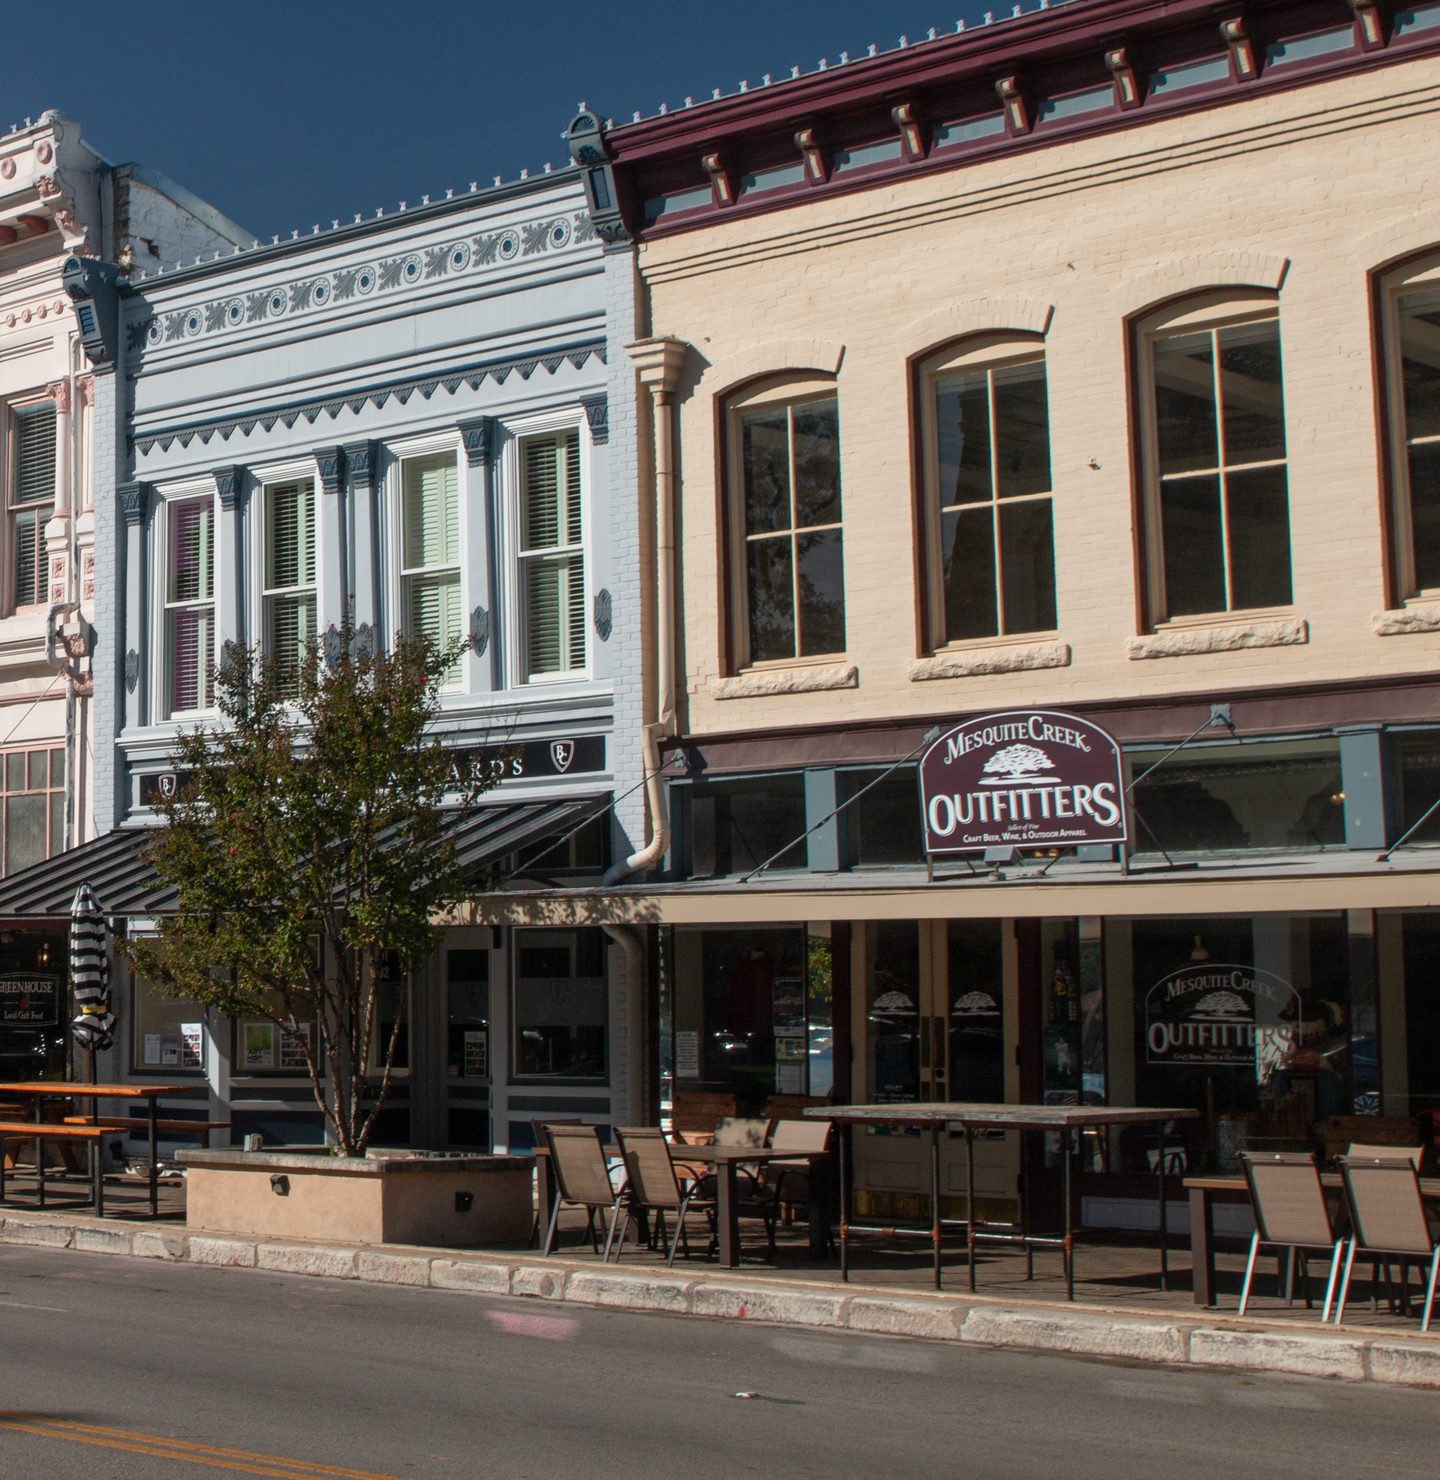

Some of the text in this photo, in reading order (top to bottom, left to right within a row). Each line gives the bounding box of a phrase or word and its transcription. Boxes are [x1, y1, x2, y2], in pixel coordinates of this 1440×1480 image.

[928, 782, 1121, 836] OUTFITTERS
[4, 1010, 18, 1019] Local
[1148, 1021, 1296, 1054] OUTFITTERS
